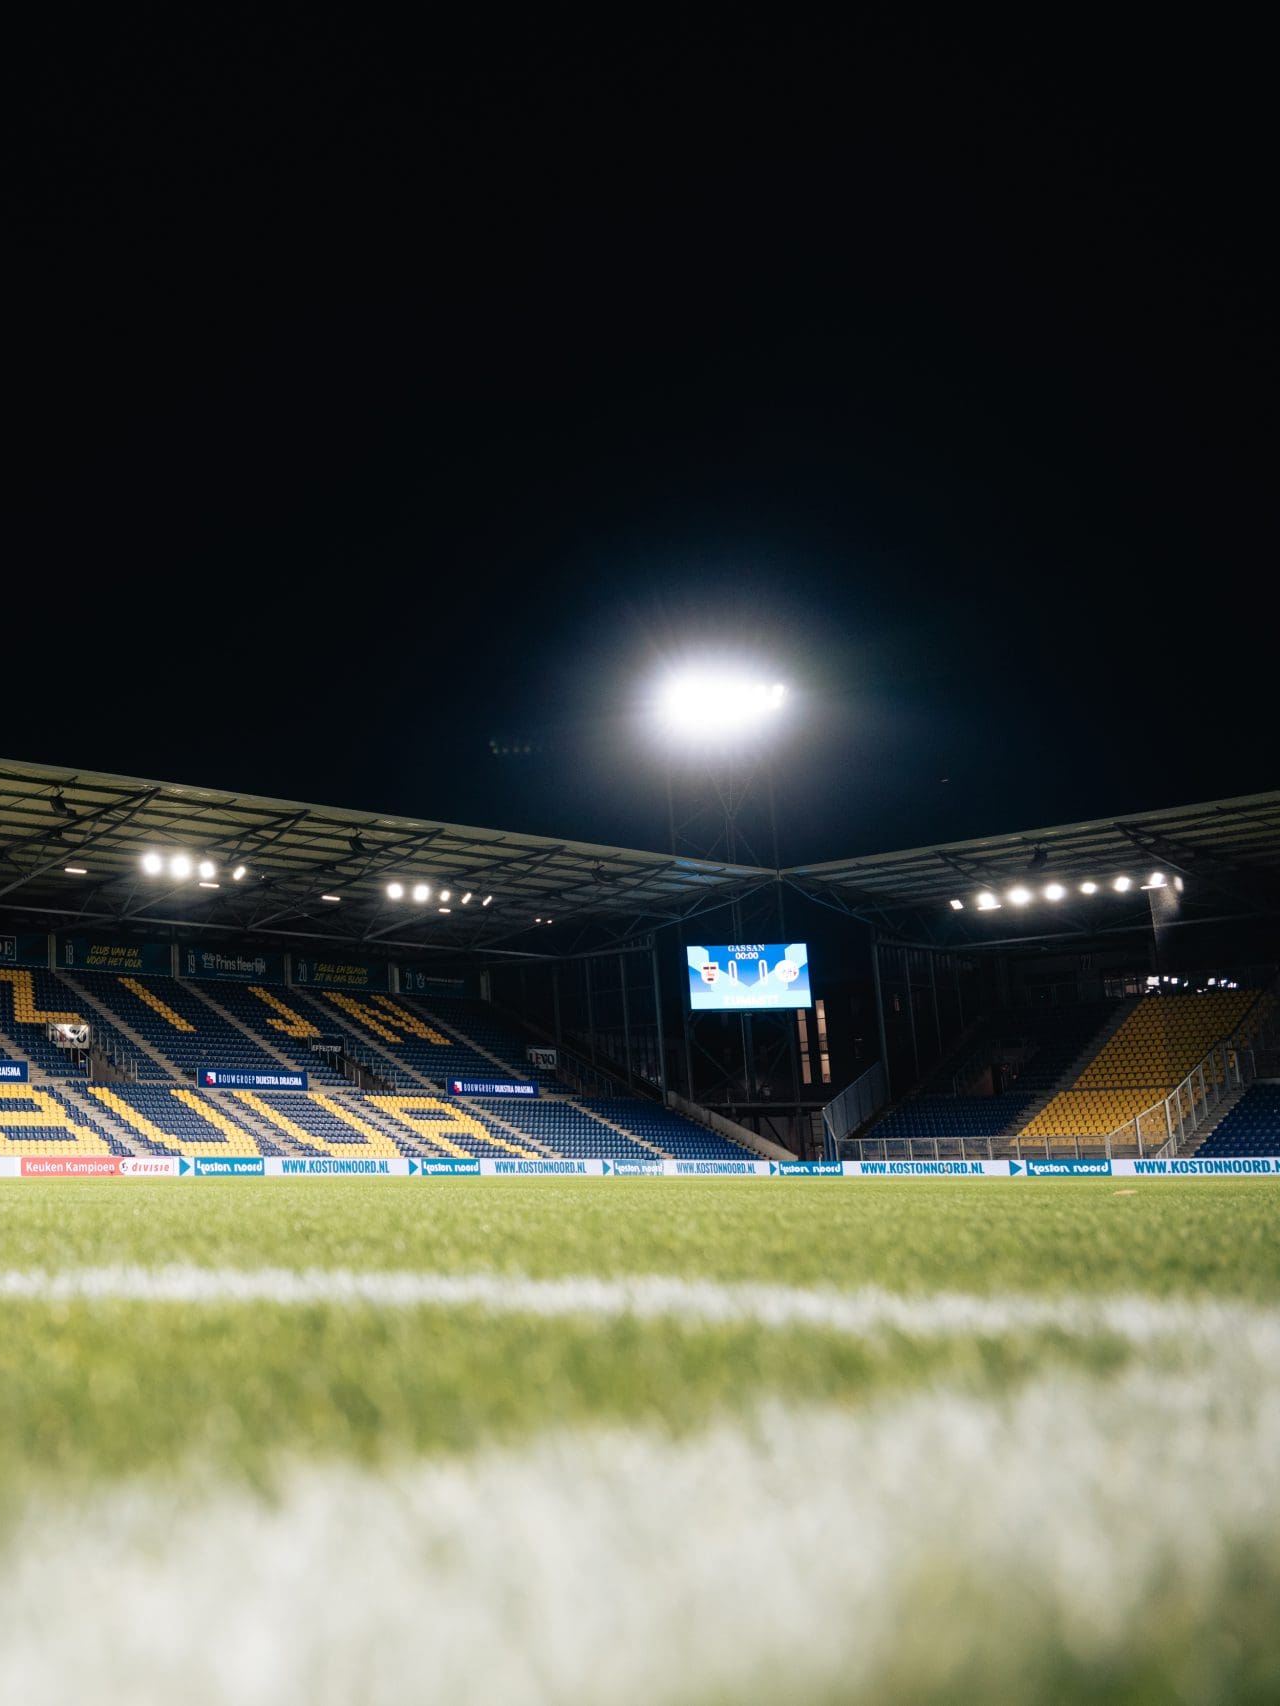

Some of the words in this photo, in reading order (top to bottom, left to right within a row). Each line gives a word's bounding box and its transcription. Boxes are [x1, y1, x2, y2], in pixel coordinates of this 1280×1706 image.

[127, 948, 139, 957] EN
[728, 944, 765, 952] GASSAN
[65, 944, 74, 965] 18
[735, 952, 759, 960] 00:00
[86, 956, 107, 965] VOOR
[108, 957, 123, 966] HET
[123, 958, 143, 968] VOLK
[188, 954, 196, 974] 19
[298, 963, 307, 982] 20
[218, 1074, 255, 1084] BOUWGROEP
[256, 1075, 279, 1085] DIJKSTRA
[280, 1077, 302, 1086] DRAISMA
[26, 1161, 64, 1172] Keuken
[66, 1161, 115, 1174] Kampioen
[132, 1162, 170, 1172] divisie
[197, 1160, 232, 1175] koston
[234, 1160, 263, 1172] noord
[282, 1160, 390, 1173] WWW.KOSTONNOORD.NL
[454, 1161, 479, 1172] noord
[495, 1161, 587, 1173] WWW.KOSTONNOORD.NL
[676, 1162, 756, 1174] WWW.KOSTONNOORD.NL
[812, 1163, 841, 1173] noord
[860, 1162, 985, 1174] WWW.KOSTONNOORD.NL
[1029, 1162, 1070, 1175] koston
[1073, 1162, 1109, 1173] noord
